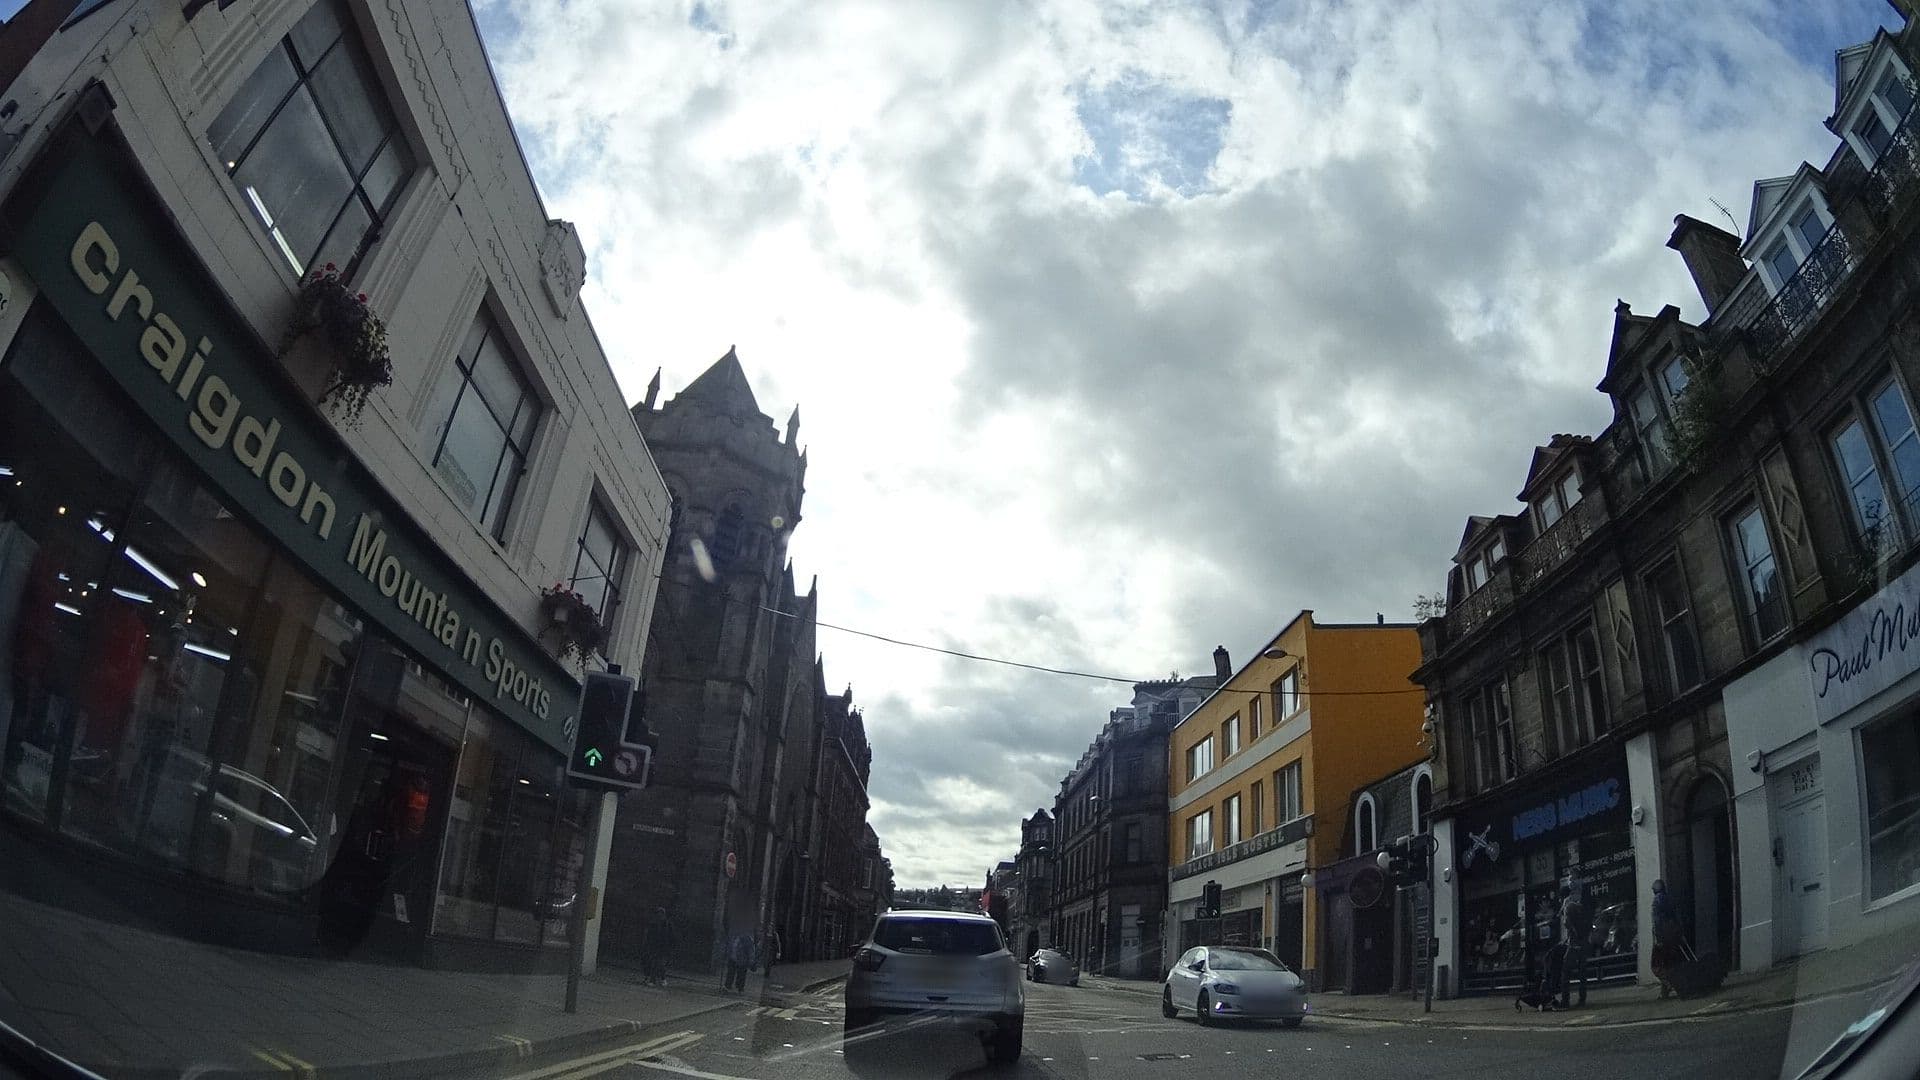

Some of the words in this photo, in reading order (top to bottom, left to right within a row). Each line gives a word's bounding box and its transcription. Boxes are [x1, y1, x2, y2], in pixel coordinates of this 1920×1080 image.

[71, 221, 336, 540] craigdon
[347, 512, 481, 666] Mountan
[485, 638, 550, 720] Sports
[1812, 634, 1871, 697] Paul
[1871, 602, 1920, 661] Mu
[1188, 859, 1213, 874] BLACK
[1217, 848, 1238, 863] ISLE
[1243, 831, 1285, 855] HOSTEL
[1590, 882, 1609, 896] Hi-Fi
